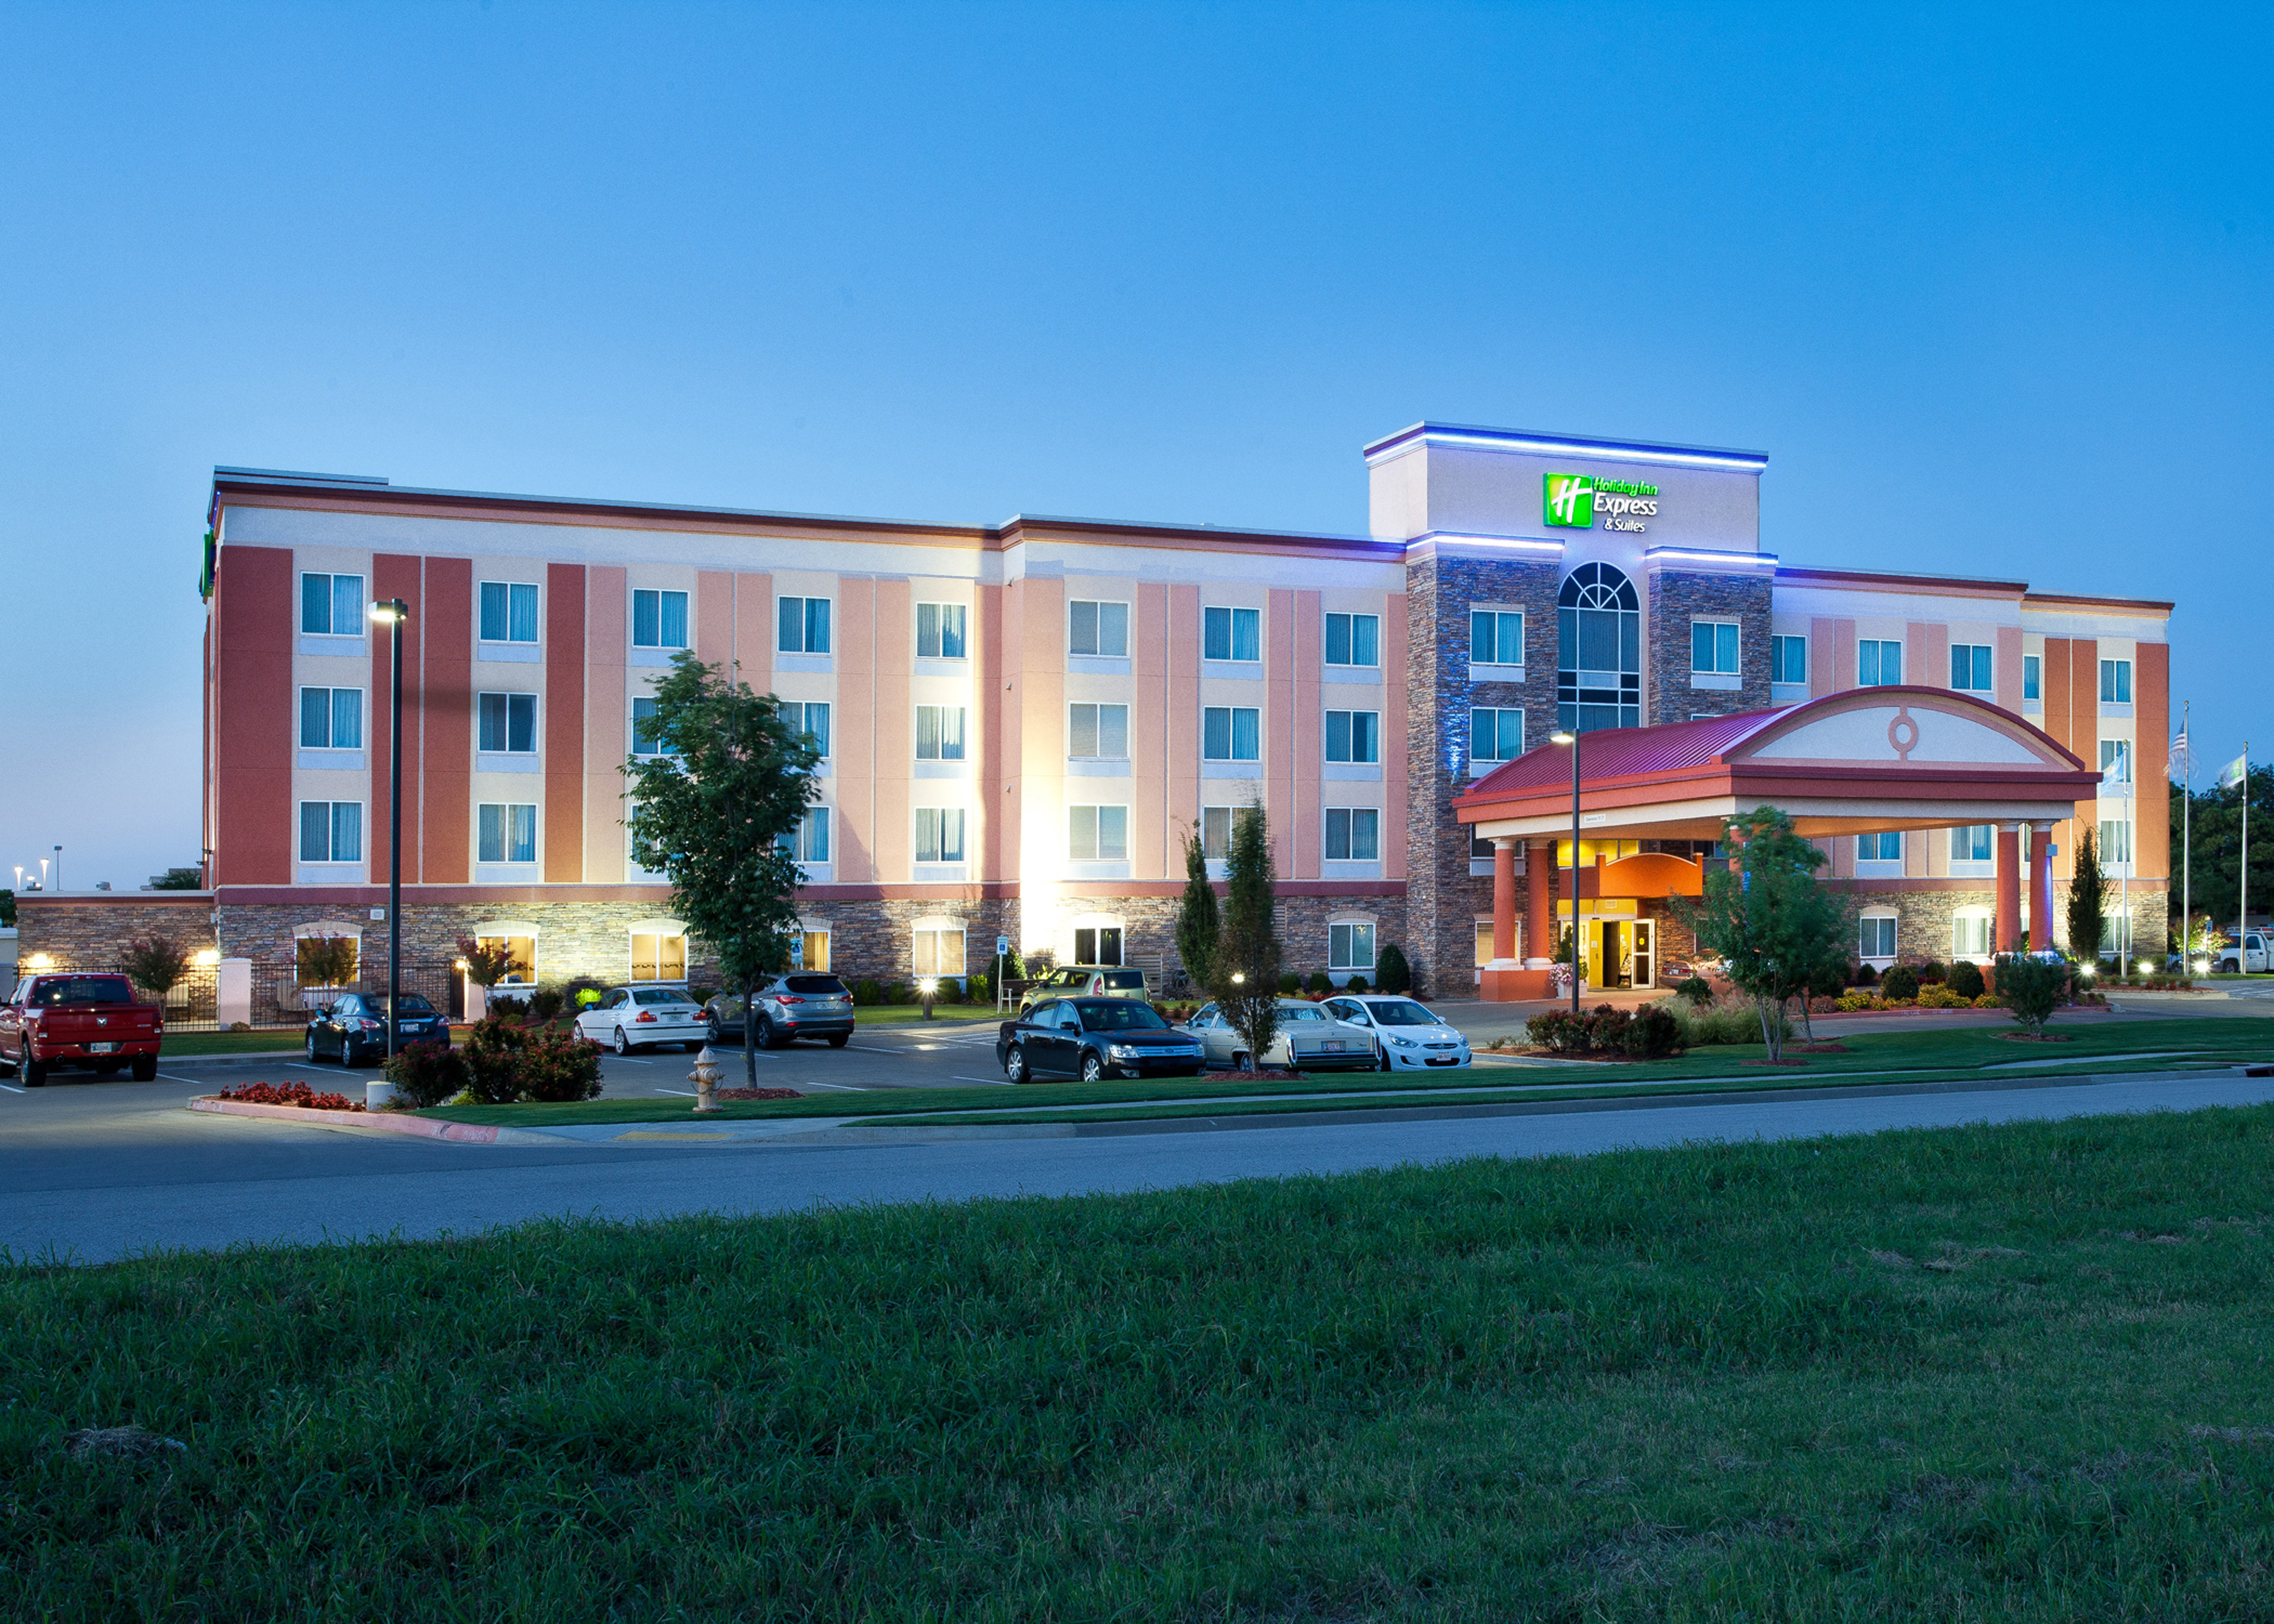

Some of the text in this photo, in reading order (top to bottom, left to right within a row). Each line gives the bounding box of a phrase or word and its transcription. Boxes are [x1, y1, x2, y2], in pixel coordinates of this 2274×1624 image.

[1593, 477, 1658, 497] Holiday Inn
[1593, 492, 1658, 517] Express
[1604, 518, 1645, 532] & Suites
